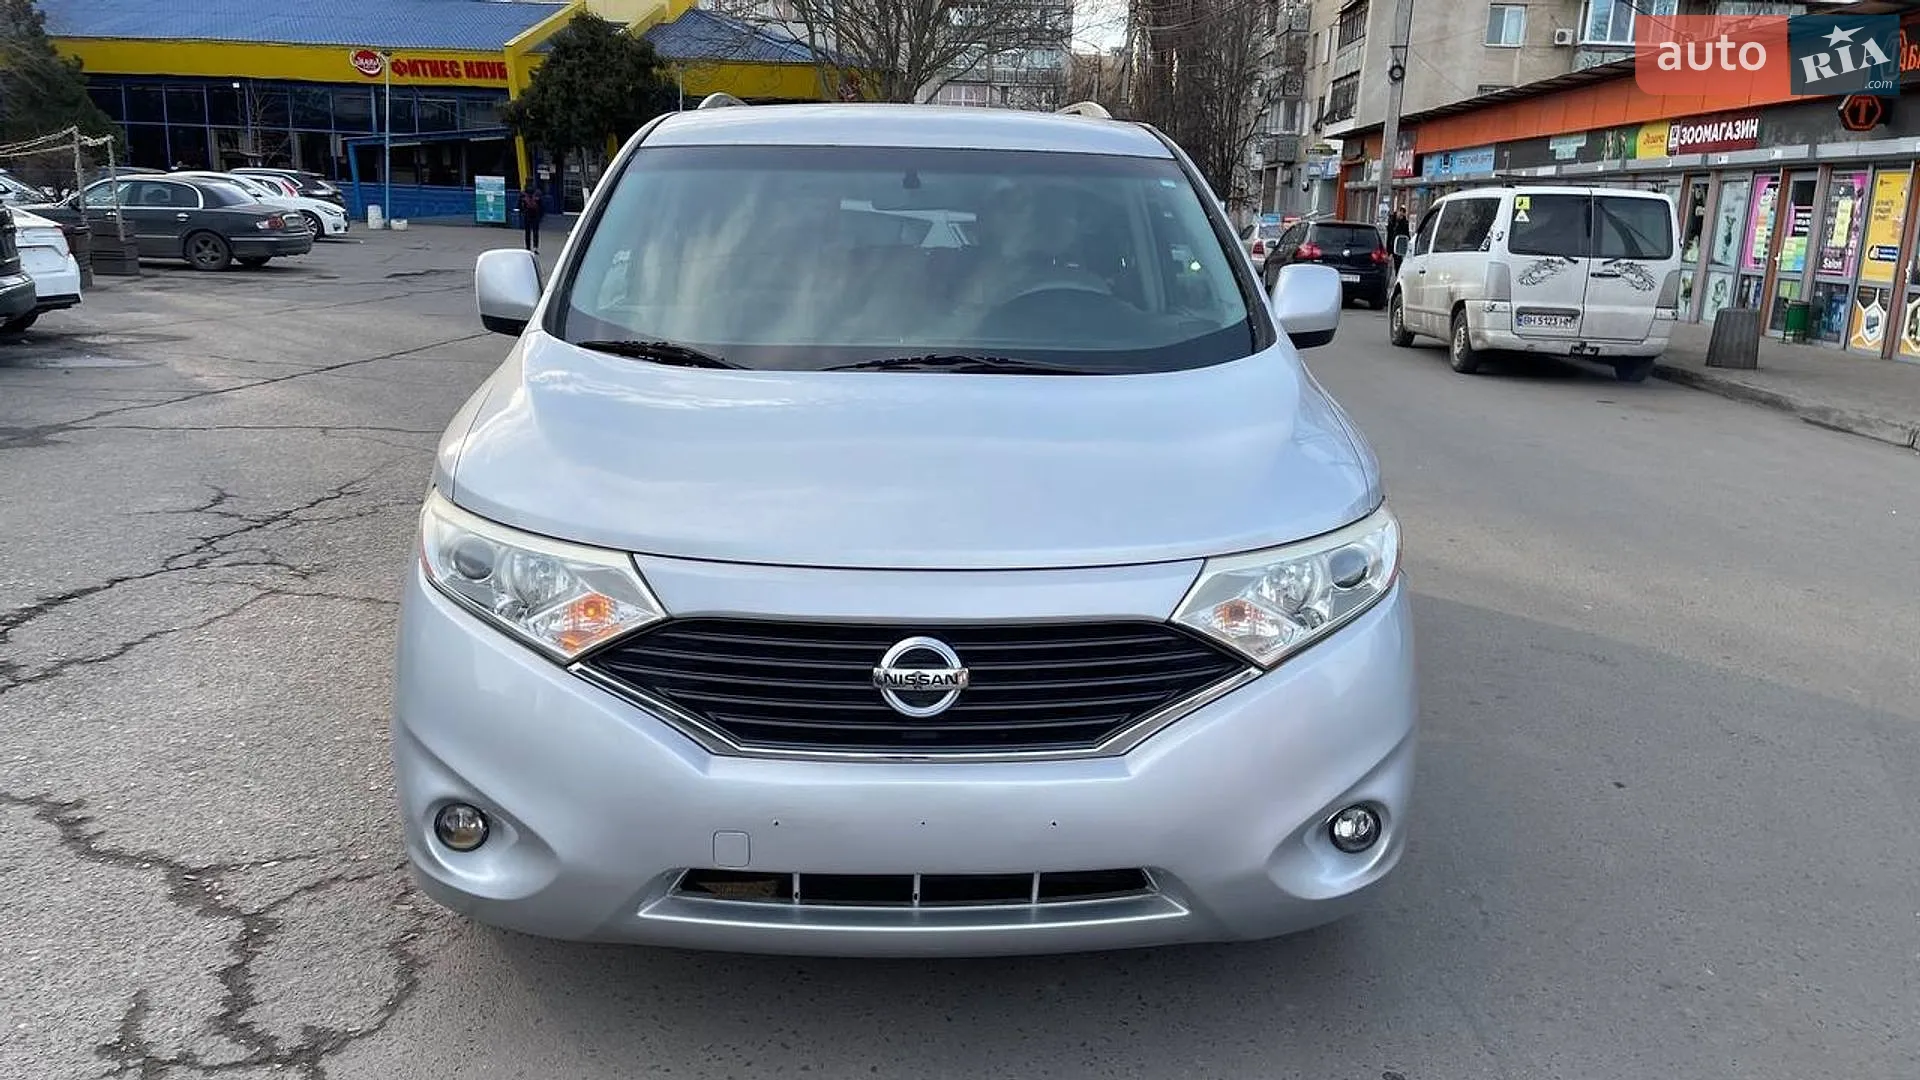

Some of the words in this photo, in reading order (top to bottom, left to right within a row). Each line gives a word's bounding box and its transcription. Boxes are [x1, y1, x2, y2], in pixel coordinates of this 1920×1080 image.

[391, 58, 461, 79] ФИТНЕС
[463, 60, 508, 81] КЛУБ
[1679, 118, 1759, 145] ЗООМАГАЗИН
[883, 673, 959, 686] NISSAN
